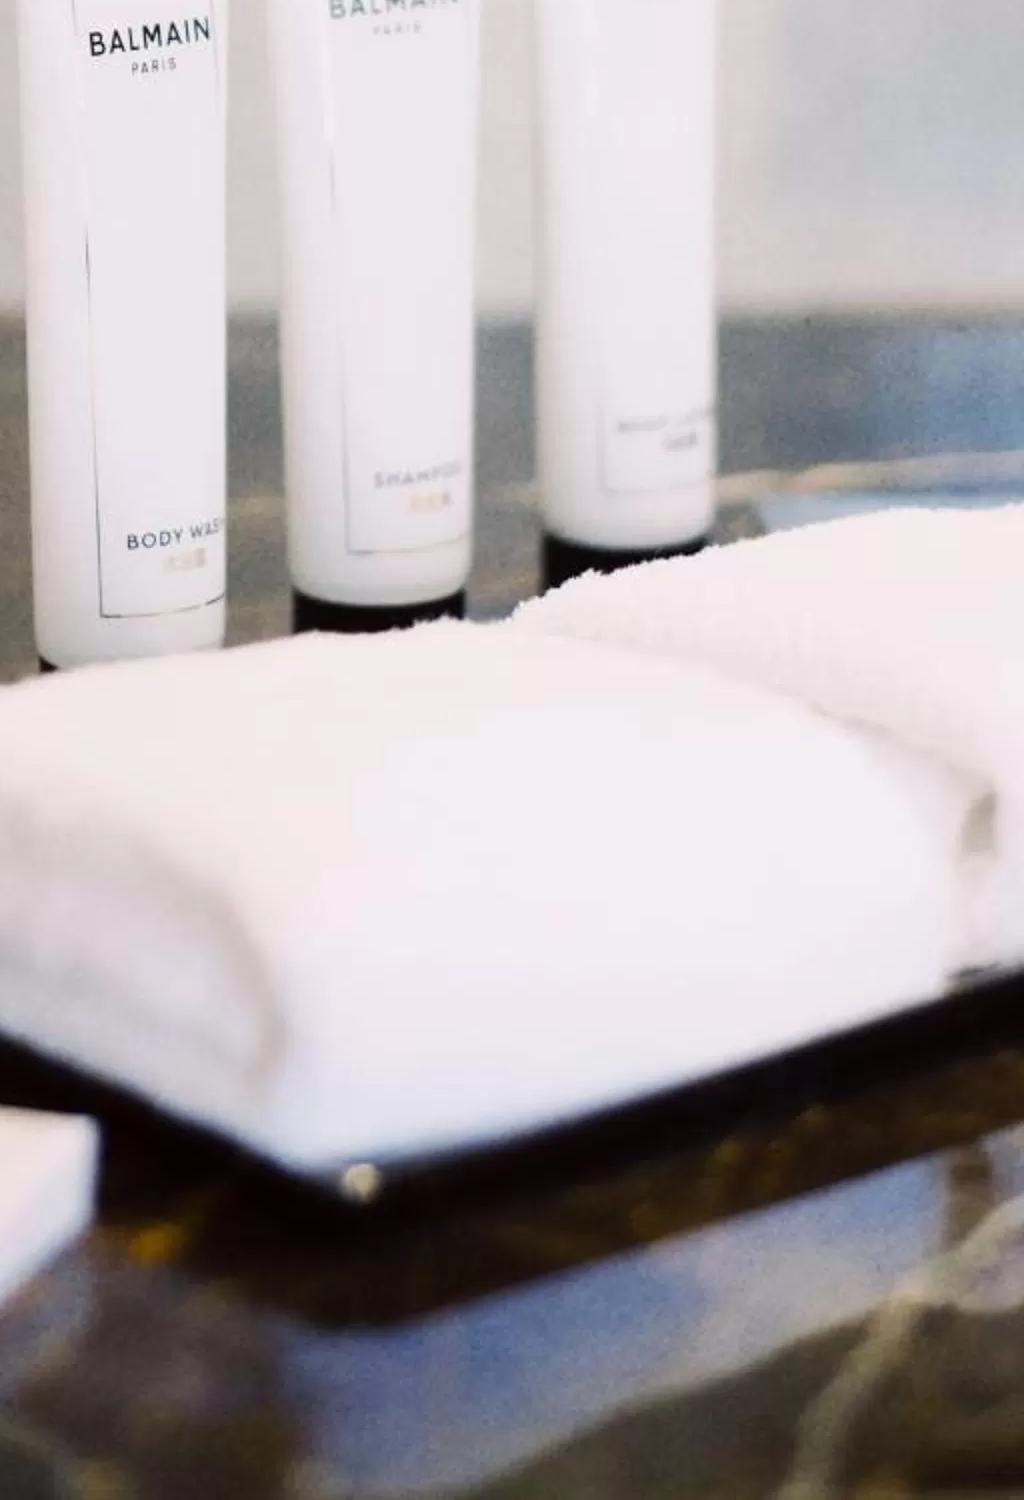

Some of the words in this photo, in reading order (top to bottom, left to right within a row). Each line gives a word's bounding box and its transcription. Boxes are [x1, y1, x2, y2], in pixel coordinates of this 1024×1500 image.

[89, 16, 210, 57] BALMAIN
[132, 57, 177, 77] PARIS
[127, 527, 184, 550] BODY
